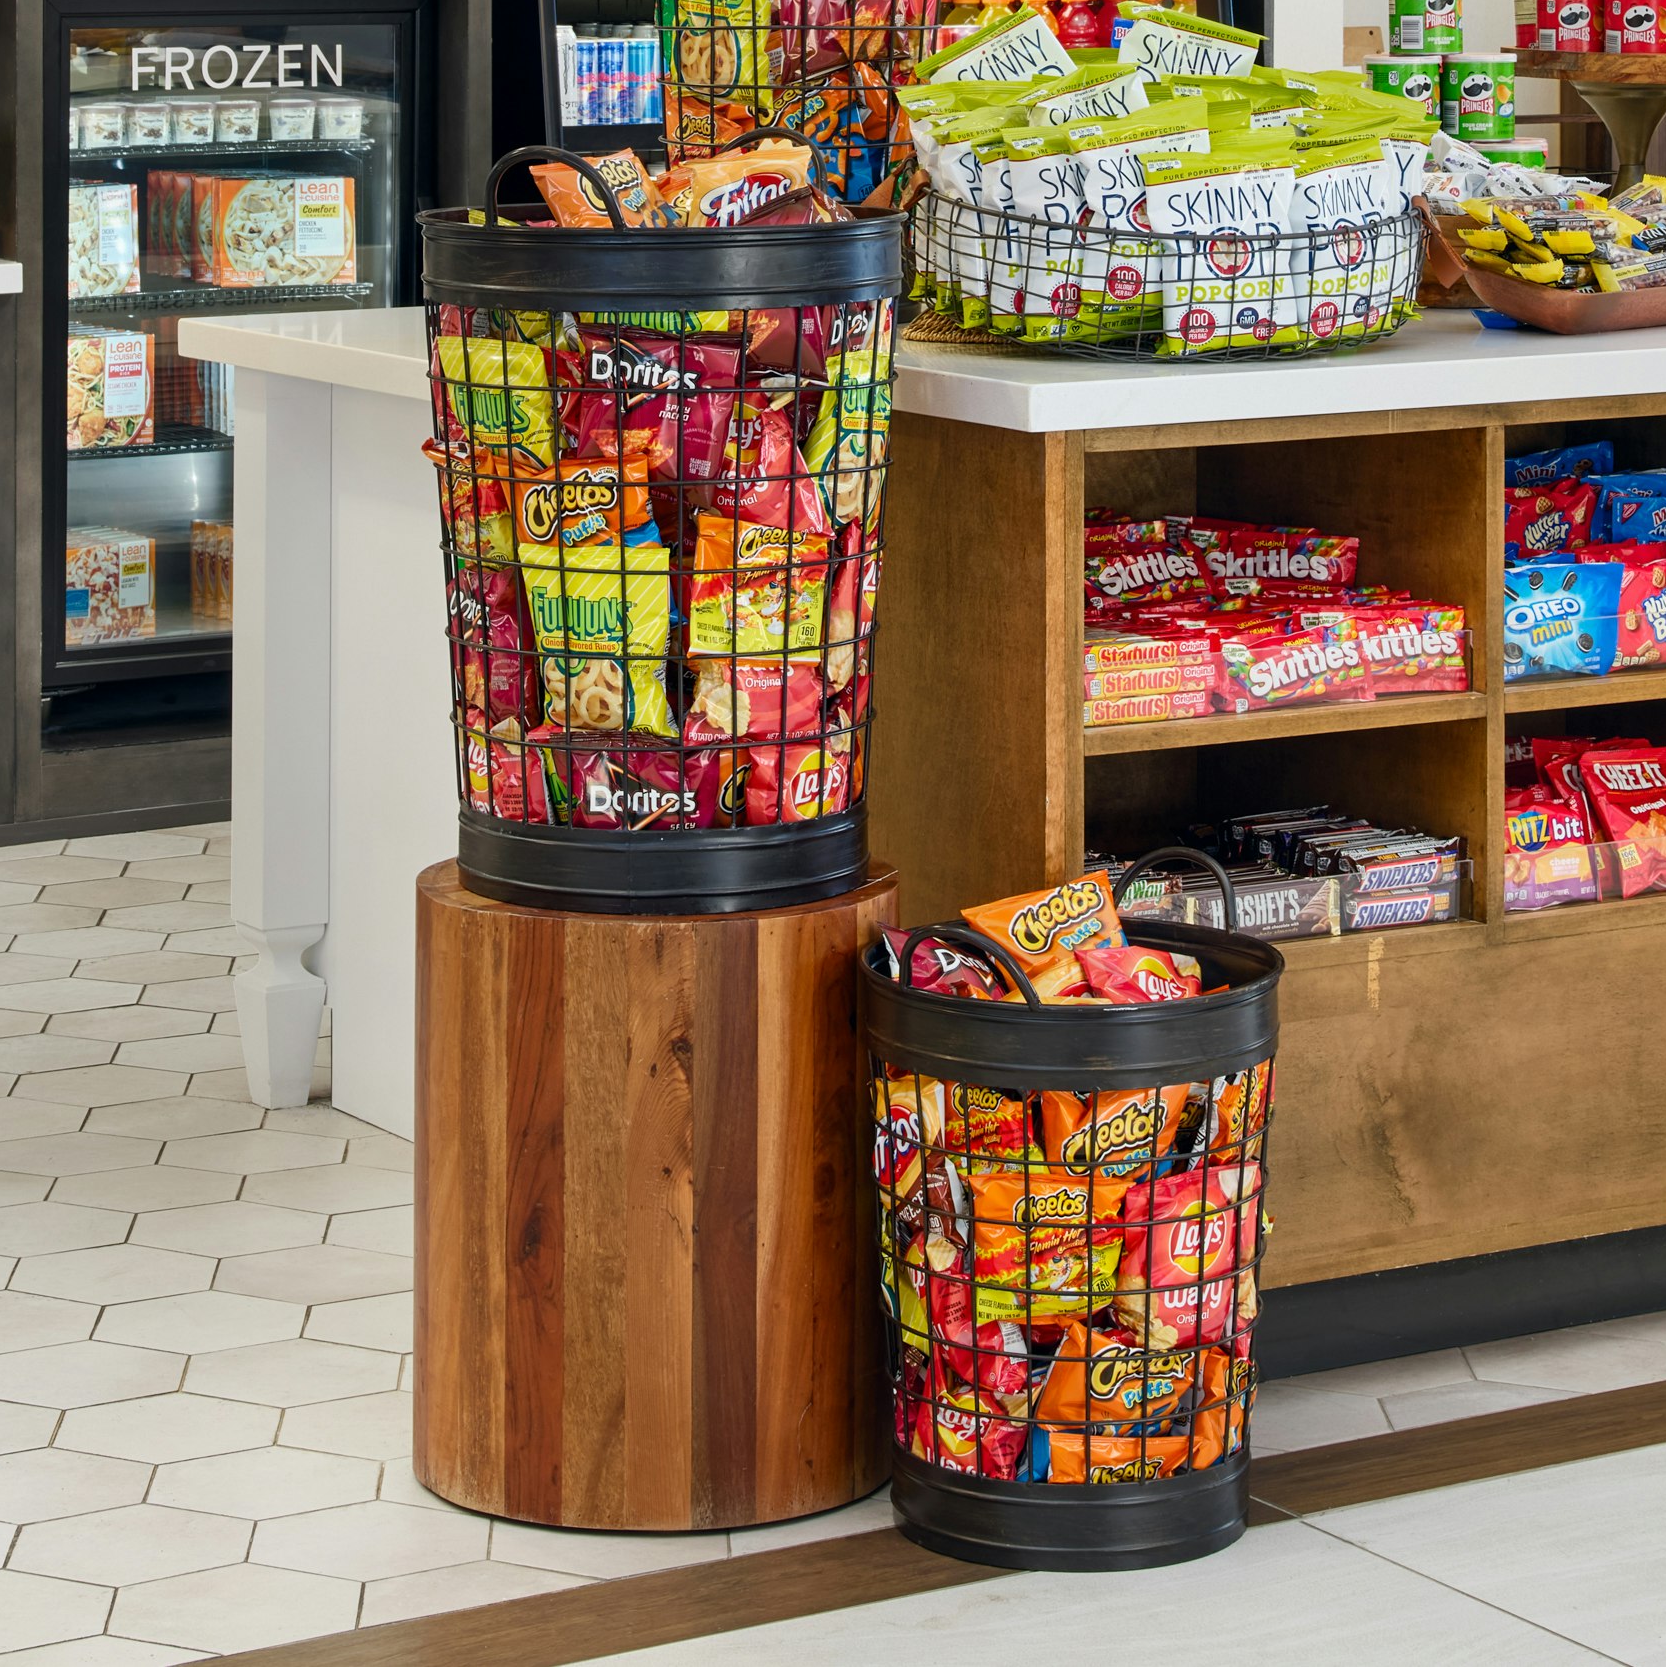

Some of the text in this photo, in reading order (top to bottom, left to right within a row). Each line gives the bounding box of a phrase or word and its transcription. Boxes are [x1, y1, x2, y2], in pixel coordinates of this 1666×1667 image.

[1426, 11, 1455, 28] PRINGLES
[1558, 27, 1590, 42] PRINGLES
[1623, 30, 1655, 45] PRINGLES
[132, 44, 342, 91] FROZEN
[1461, 98, 1494, 113] PRINGLES
[1189, 168, 1219, 176] POPPED
[302, 204, 336, 215] Comfort
[1190, 314, 1209, 326] 100
[1240, 316, 1255, 324] GMO
[110, 363, 141, 372] PROTEIN
[592, 353, 698, 389] Doritos
[1516, 465, 1557, 483] Mini
[1099, 551, 1199, 596] Skittles
[1206, 548, 1331, 582] Skittles
[1506, 597, 1580, 625] OREO
[1532, 619, 1573, 644] mini
[545, 638, 615, 651] Onion Rings
[1180, 640, 1210, 653] Original
[1099, 645, 1175, 665] Starburst
[1185, 665, 1215, 678] Original
[1249, 643, 1359, 697] Skittles
[745, 677, 783, 691] Original
[1104, 671, 1180, 694] Starburst
[1093, 698, 1170, 721] Starburst
[689, 733, 713, 741] POTATO
[590, 785, 696, 813] Doritos
[1508, 813, 1551, 846] RITZ
[1549, 857, 1580, 867] cheese
[1363, 861, 1436, 891] SNICKERS
[1010, 882, 1101, 952] Cheetos
[1211, 889, 1300, 930] HRSHEY'S
[1355, 900, 1429, 928] SNICKERS
[1174, 1215, 1225, 1255] Lay's
